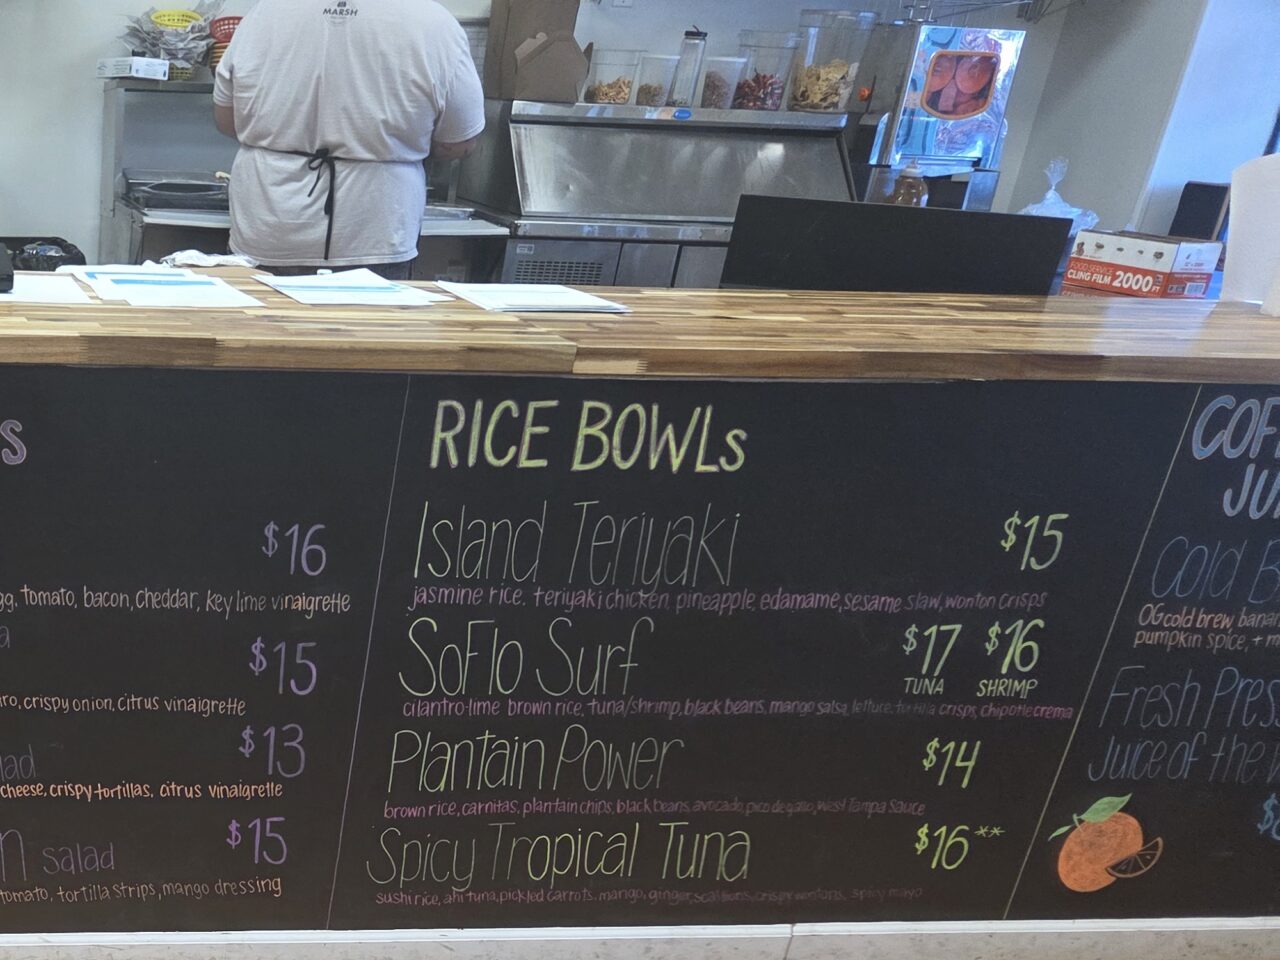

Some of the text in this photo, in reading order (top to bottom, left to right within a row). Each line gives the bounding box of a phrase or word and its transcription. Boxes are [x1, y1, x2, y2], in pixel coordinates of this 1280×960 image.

[322, 8, 358, 16] MARSH
[1067, 270, 1153, 292] CLING FILM 2000
[1088, 264, 1115, 276] SERVICE
[429, 398, 560, 470] RICE
[261, 520, 328, 577] $16
[414, 500, 1070, 600] Island Teriyaki $15
[1151, 536, 1248, 600] Cold
[206, 588, 235, 620] key
[236, 588, 267, 611] lime
[271, 589, 352, 619] vinaigrette
[407, 584, 484, 612] jasmine
[1163, 606, 1196, 628] cold
[398, 616, 1045, 697] SoFlo Surf $17 $16
[1133, 630, 1202, 653] pumpkin
[248, 636, 318, 696] $15
[903, 677, 1038, 699] TUNA SHRIMP
[1098, 665, 1202, 729] Fresh
[24, 691, 70, 714] crispy
[118, 692, 160, 713] citrus
[164, 693, 247, 718] vinaigrette
[507, 699, 551, 717] brown
[238, 723, 307, 778] $13
[387, 724, 981, 793] Plantain Power $14
[1088, 735, 1163, 782] Juice
[1166, 731, 1208, 780] of
[159, 780, 202, 799] citrus
[208, 780, 283, 801] vinaigrette
[383, 801, 426, 819] brown
[43, 842, 115, 875] salad
[226, 816, 288, 866] $15
[366, 827, 475, 892] Spicy
[488, 822, 639, 889] Tropical
[659, 822, 751, 882] Tuna
[56, 883, 111, 904] tortilla
[162, 880, 210, 901] mango
[214, 876, 282, 898] dressing
